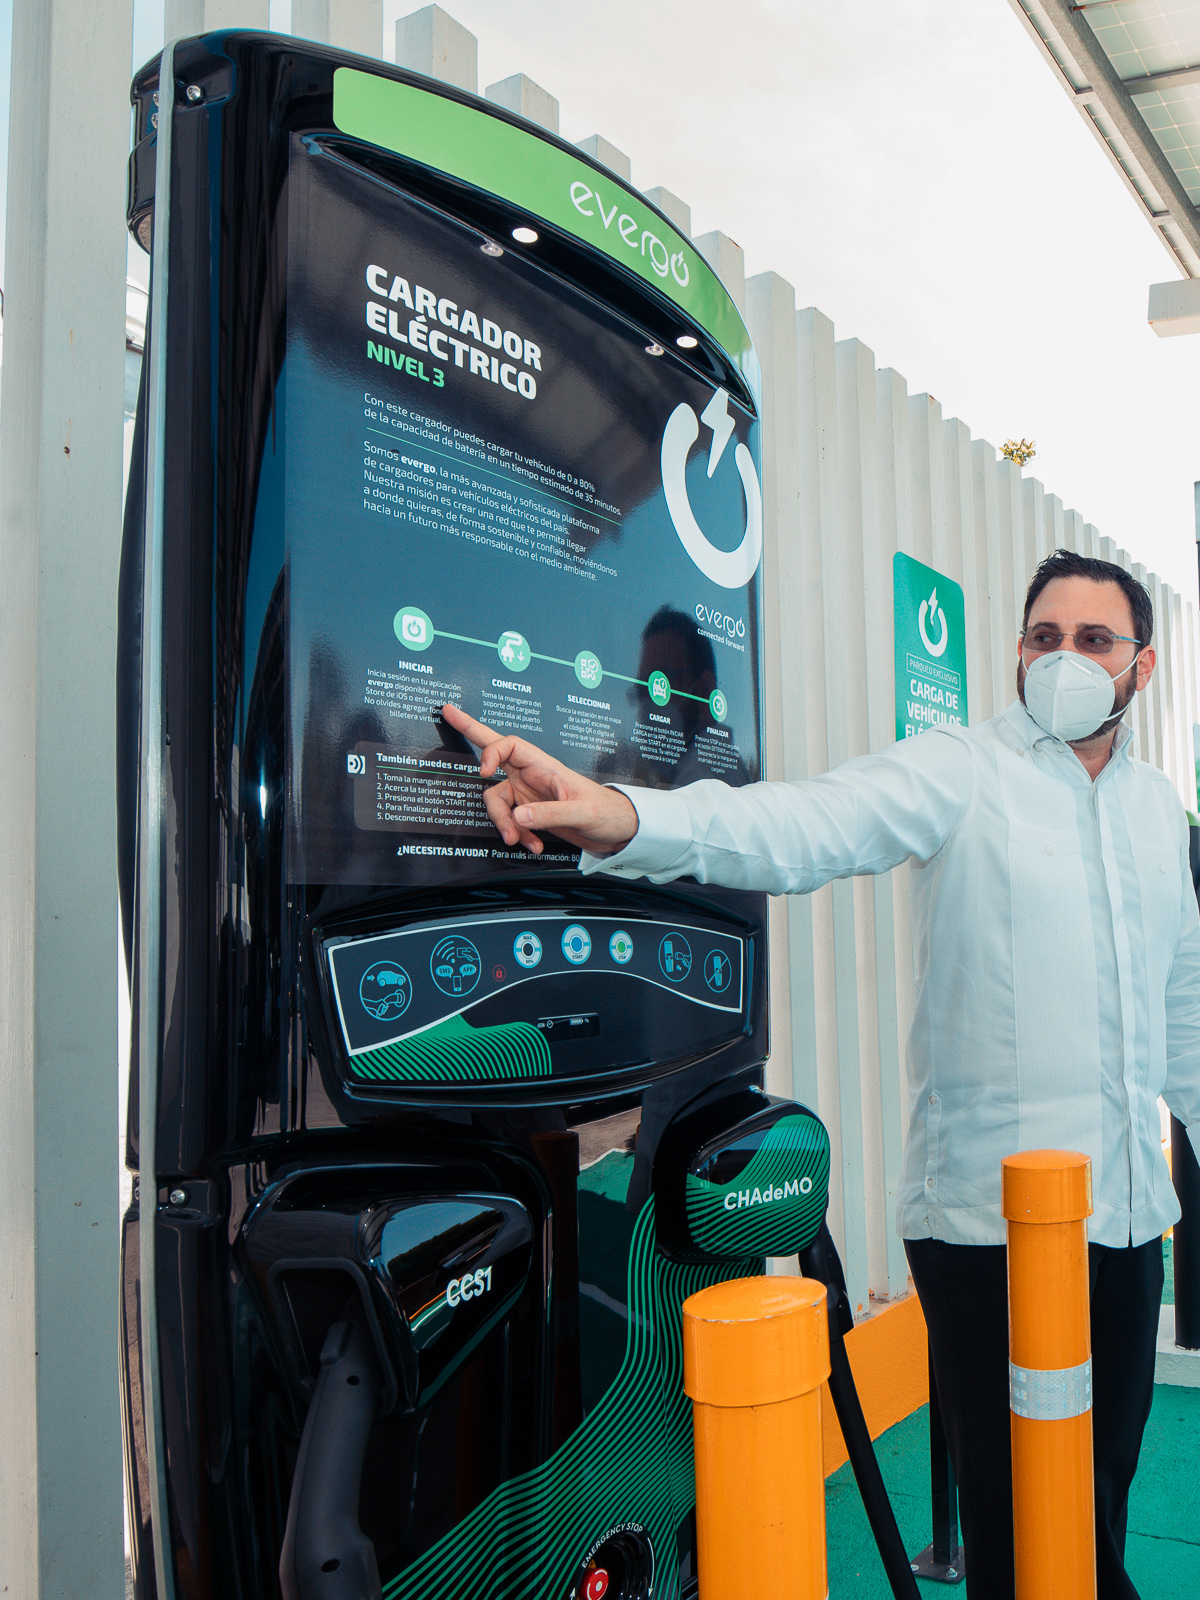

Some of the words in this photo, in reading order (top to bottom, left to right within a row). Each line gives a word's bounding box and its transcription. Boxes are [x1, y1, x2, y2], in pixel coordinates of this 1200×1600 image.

[569, 181, 690, 287] evergo
[366, 264, 542, 372] CARGADOR
[366, 301, 537, 400] ELÉCTRICO
[367, 340, 430, 383] NIVEL
[433, 367, 445, 388] 3
[364, 393, 383, 408] Con
[386, 402, 407, 416] este
[410, 411, 452, 433] cargador
[454, 429, 485, 446] puedes
[487, 442, 513, 457] cargar
[515, 452, 522, 462] tu
[524, 457, 555, 475] vehículo
[557, 470, 565, 480] de
[567, 474, 572, 482] 0
[574, 477, 578, 485] a
[579, 479, 595, 492] 80%
[364, 408, 377, 419] de
[379, 412, 388, 423] la
[391, 419, 439, 442] capacidad
[442, 436, 453, 447] de
[455, 440, 485, 459] batería
[488, 454, 498, 464] en
[500, 460, 510, 469] un
[512, 463, 538, 480] tiempo
[540, 476, 573, 495] estimado
[575, 490, 583, 499] de
[585, 495, 593, 503] 35
[594, 499, 622, 515] minutos.
[364, 441, 399, 461] Somos
[401, 456, 437, 475] evergo,
[440, 467, 448, 478] la
[451, 473, 469, 486] más
[471, 481, 512, 500] avanzada
[513, 495, 518, 503] y
[520, 499, 560, 518] sofisticada
[562, 514, 600, 534] plataforma
[364, 457, 376, 468] de
[379, 463, 433, 486] cargadores
[436, 482, 456, 494] para
[458, 489, 499, 509] vehículos
[501, 503, 539, 523] eléctricos
[541, 518, 552, 528] del
[554, 524, 570, 535] país.
[364, 470, 404, 490] Nuestra
[407, 486, 438, 501] misión
[441, 496, 451, 506] es
[453, 501, 476, 513] crear
[478, 509, 493, 520] una
[496, 514, 509, 525] red
[511, 520, 525, 531] que
[527, 525, 534, 534] te
[537, 530, 565, 545] permita
[566, 539, 586, 553] llegar
[364, 499, 390, 515] hacia
[393, 509, 406, 519] un
[408, 512, 438, 529] futuro
[440, 523, 460, 536] más
[462, 530, 513, 553] responsable
[515, 549, 529, 558] con
[531, 553, 538, 561] el
[540, 556, 562, 568] medio
[564, 563, 597, 581] ambiente.
[372, 488, 404, 505] donde
[407, 499, 444, 518] quieras,
[446, 511, 457, 521] de
[459, 514, 485, 530] forma
[487, 526, 528, 545] sostenible
[530, 540, 535, 549] y
[537, 542, 571, 561] confiable,
[573, 555, 617, 577] moviéndonos
[695, 604, 745, 637] evergo
[697, 628, 724, 643] connected
[726, 638, 744, 652] forward
[368, 668, 386, 678] Inicia
[388, 673, 410, 682] sesión
[429, 681, 461, 691] aplicación
[399, 661, 433, 674] INICIAR
[910, 659, 932, 675] PARQUEO
[933, 668, 958, 684] EXCLUSIVO
[492, 679, 531, 693] CONECTAR
[910, 679, 944, 705] CARGA
[946, 691, 958, 710] DE
[567, 695, 610, 710] SELECCIONAR
[649, 713, 670, 724] CARGAR
[376, 753, 417, 765] También
[419, 760, 451, 769] puedes
[383, 773, 402, 782] Toma
[412, 777, 446, 786] manguera
[459, 782, 482, 790] soporte
[384, 784, 408, 792] Acerca
[418, 787, 440, 795] tarjeta
[442, 790, 465, 798] evergo
[385, 793, 415, 803] Presiona
[385, 803, 402, 811] Para
[403, 804, 431, 813] finalizar
[440, 808, 465, 817] proceso
[385, 814, 425, 823] Desconecta
[435, 816, 463, 825] cargador
[398, 846, 453, 856] ¿NECESITAS
[455, 849, 488, 857] AYUDA?
[492, 850, 509, 858] Para
[511, 851, 526, 860] más
[724, 1176, 813, 1210] CHAdeMO
[446, 1265, 493, 1307] CCS1
[582, 1523, 626, 1568] EMERGENCY
[626, 1522, 643, 1533] STOP
